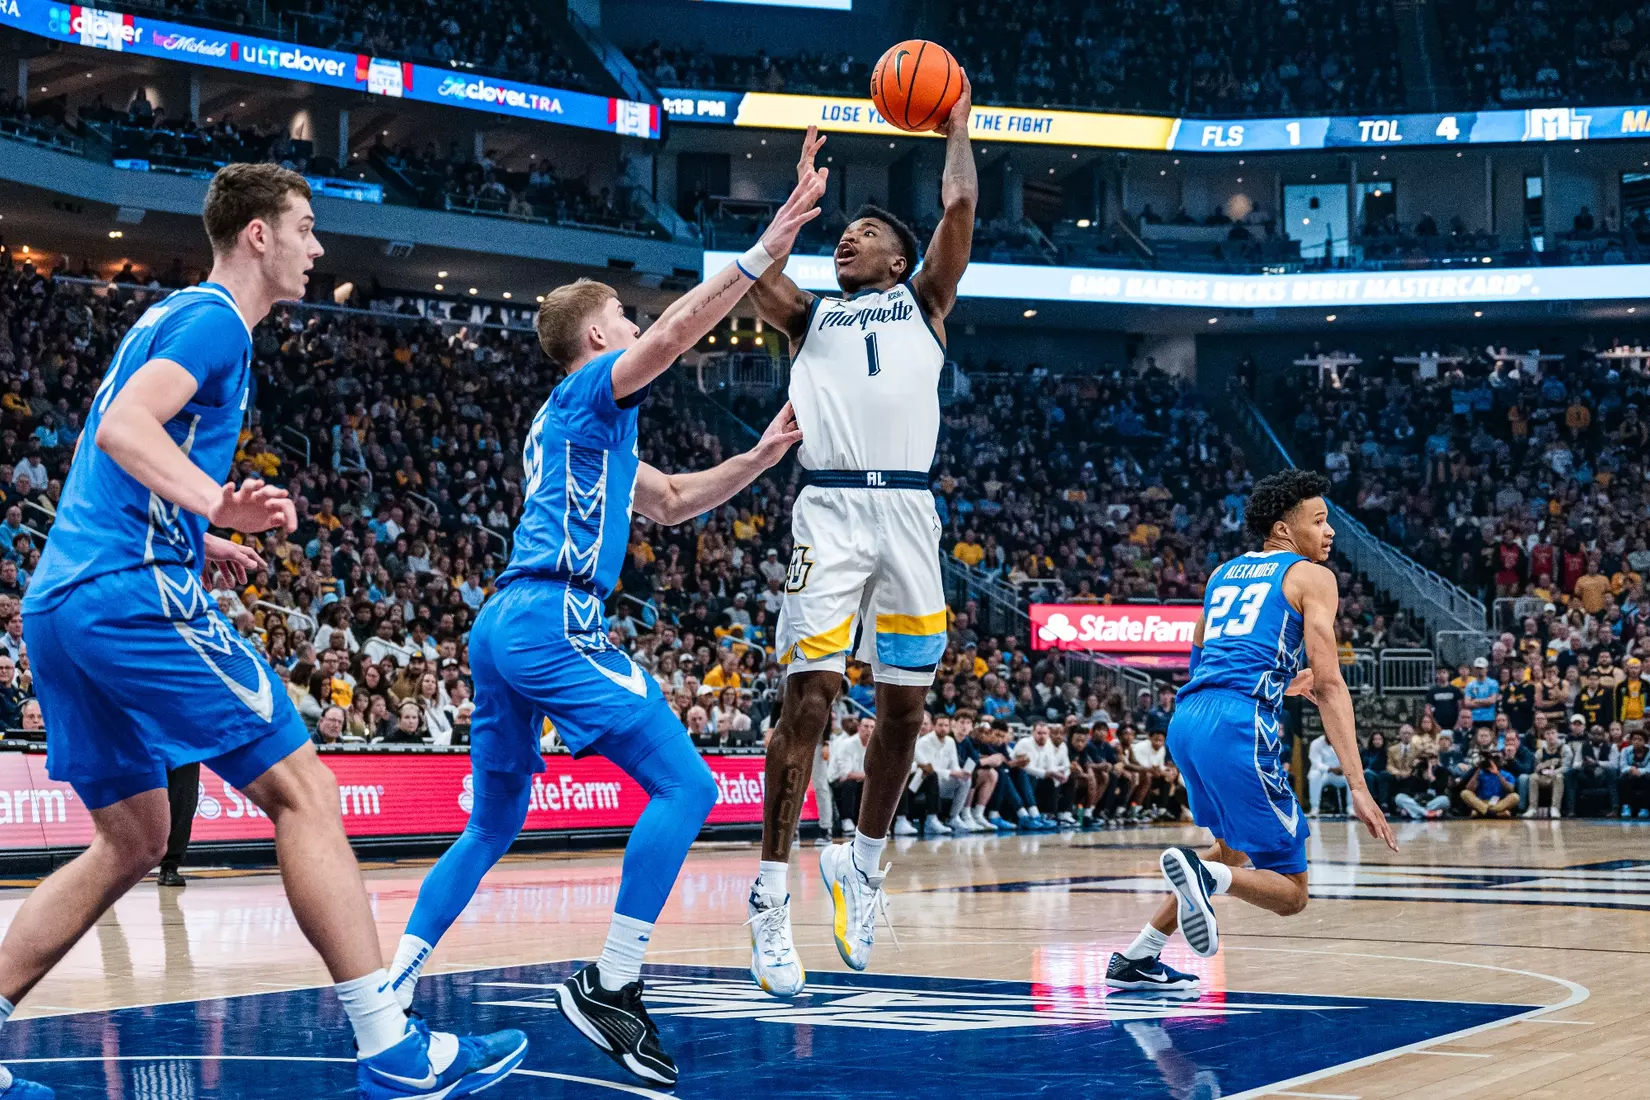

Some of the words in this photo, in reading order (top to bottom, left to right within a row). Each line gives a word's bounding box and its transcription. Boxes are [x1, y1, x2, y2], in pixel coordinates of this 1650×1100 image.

[72, 13, 143, 43] clover
[162, 33, 228, 58] Michelob
[697, 99, 726, 117] PM
[821, 104, 862, 123] LOSE
[974, 113, 1003, 131] THE
[1007, 115, 1054, 134] FIGHT
[1201, 125, 1245, 147] FLS
[1285, 122, 1301, 146] 1
[1358, 119, 1403, 143] TOL
[1435, 116, 1460, 141] 4
[1069, 274, 1121, 297] BMO
[1124, 276, 1210, 299] HARRIS
[1211, 278, 1288, 302] BUCKS
[1291, 277, 1360, 302] DEBIT
[818, 301, 913, 331] Marquette
[864, 331, 881, 376] 1
[1223, 561, 1278, 580] ALEXANDER
[1203, 582, 1272, 640] 23
